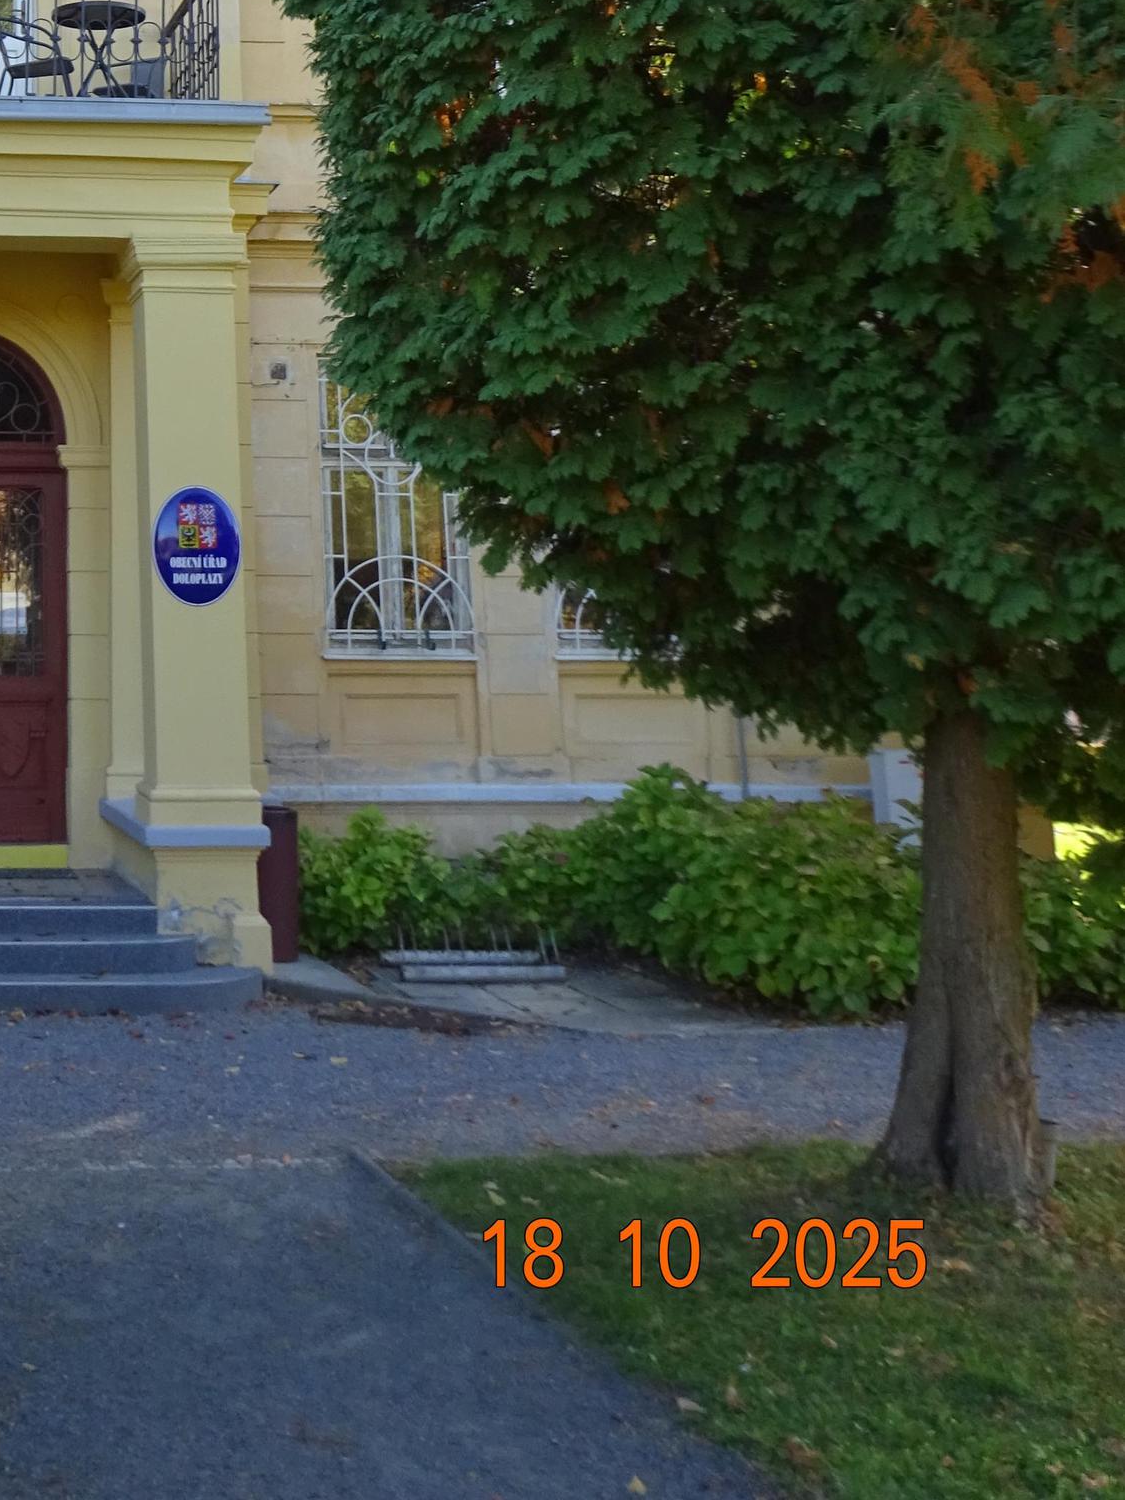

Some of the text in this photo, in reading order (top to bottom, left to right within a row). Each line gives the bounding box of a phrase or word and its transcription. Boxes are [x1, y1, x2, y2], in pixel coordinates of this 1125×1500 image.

[169, 554, 227, 568] OBECNÍ ÚŘAD
[172, 572, 224, 584] DOLOPLAZY
